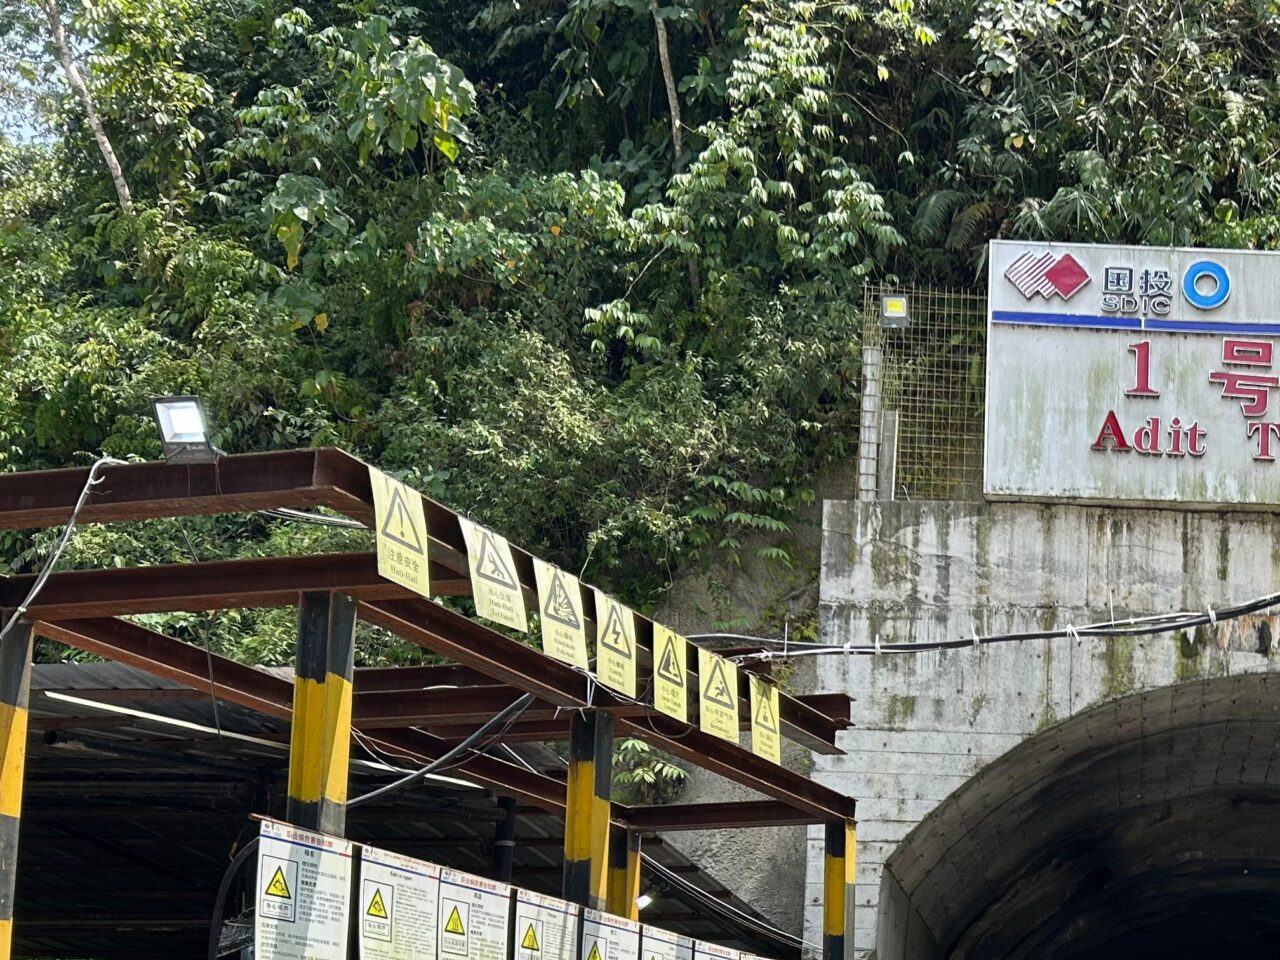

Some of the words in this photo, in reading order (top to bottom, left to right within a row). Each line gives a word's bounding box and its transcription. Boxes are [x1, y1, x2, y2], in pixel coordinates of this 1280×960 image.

[1103, 267, 1172, 297] 国投
[1101, 296, 1171, 315] SDIC
[1090, 410, 1207, 456] Adit
